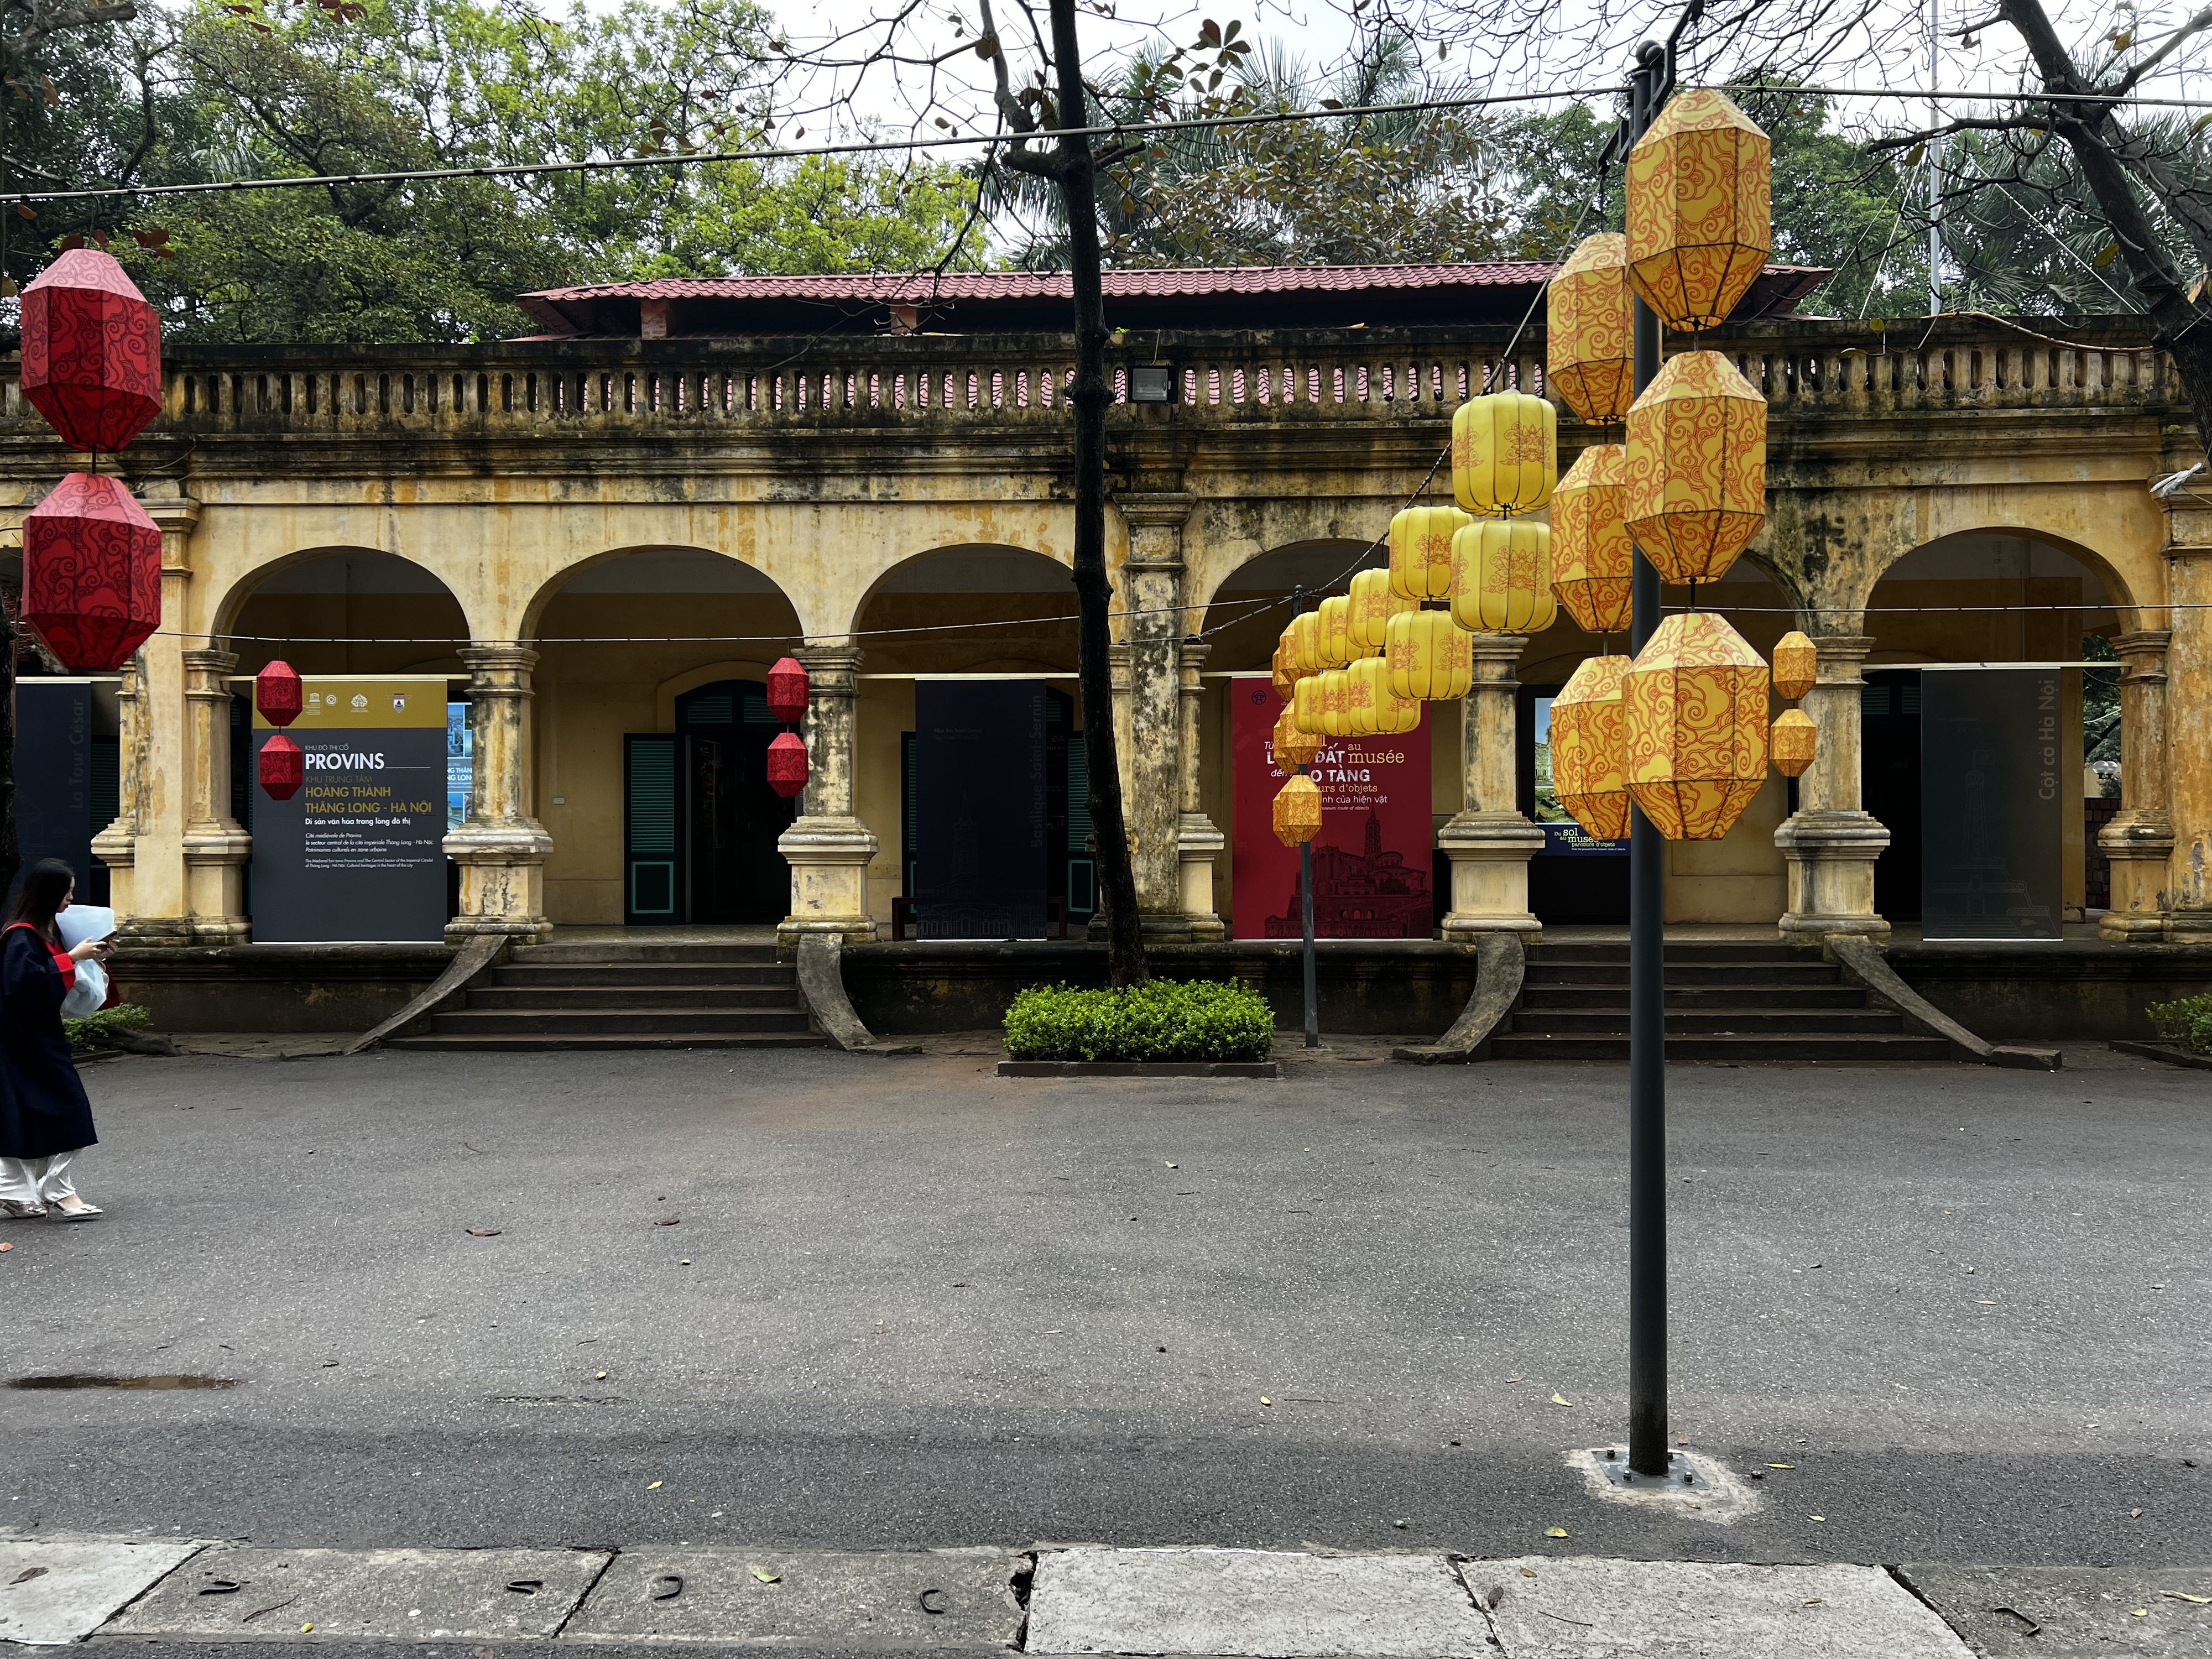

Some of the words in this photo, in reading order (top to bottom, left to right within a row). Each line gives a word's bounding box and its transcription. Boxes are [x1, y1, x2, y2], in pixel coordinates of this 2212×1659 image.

[2037, 679, 2059, 711] Nội
[69, 698, 84, 745] César
[2038, 716, 2055, 740] Hà
[305, 753, 385, 770] PROVINS
[1315, 743, 1345, 763] ĐẤT
[1348, 750, 1404, 763] musée
[69, 750, 83, 786] Tour
[1327, 764, 1370, 782] TÀNG
[355, 775, 373, 783] TÂM
[2038, 770, 2059, 800] Cột
[305, 784, 349, 797] HOÀNG
[352, 784, 391, 797] THÀNH
[1339, 784, 1378, 794] d'objets
[69, 791, 83, 810] La
[305, 801, 345, 813] THĂNG
[348, 802, 380, 813] LONG
[390, 799, 407, 812] HÀ
[410, 800, 431, 815] NỘI
[1336, 795, 1350, 803] của
[1354, 795, 1371, 805] hiện
[1374, 795, 1387, 805] vật
[375, 817, 390, 826] lòng
[402, 817, 410, 825] thị
[1563, 827, 1578, 836] sol
